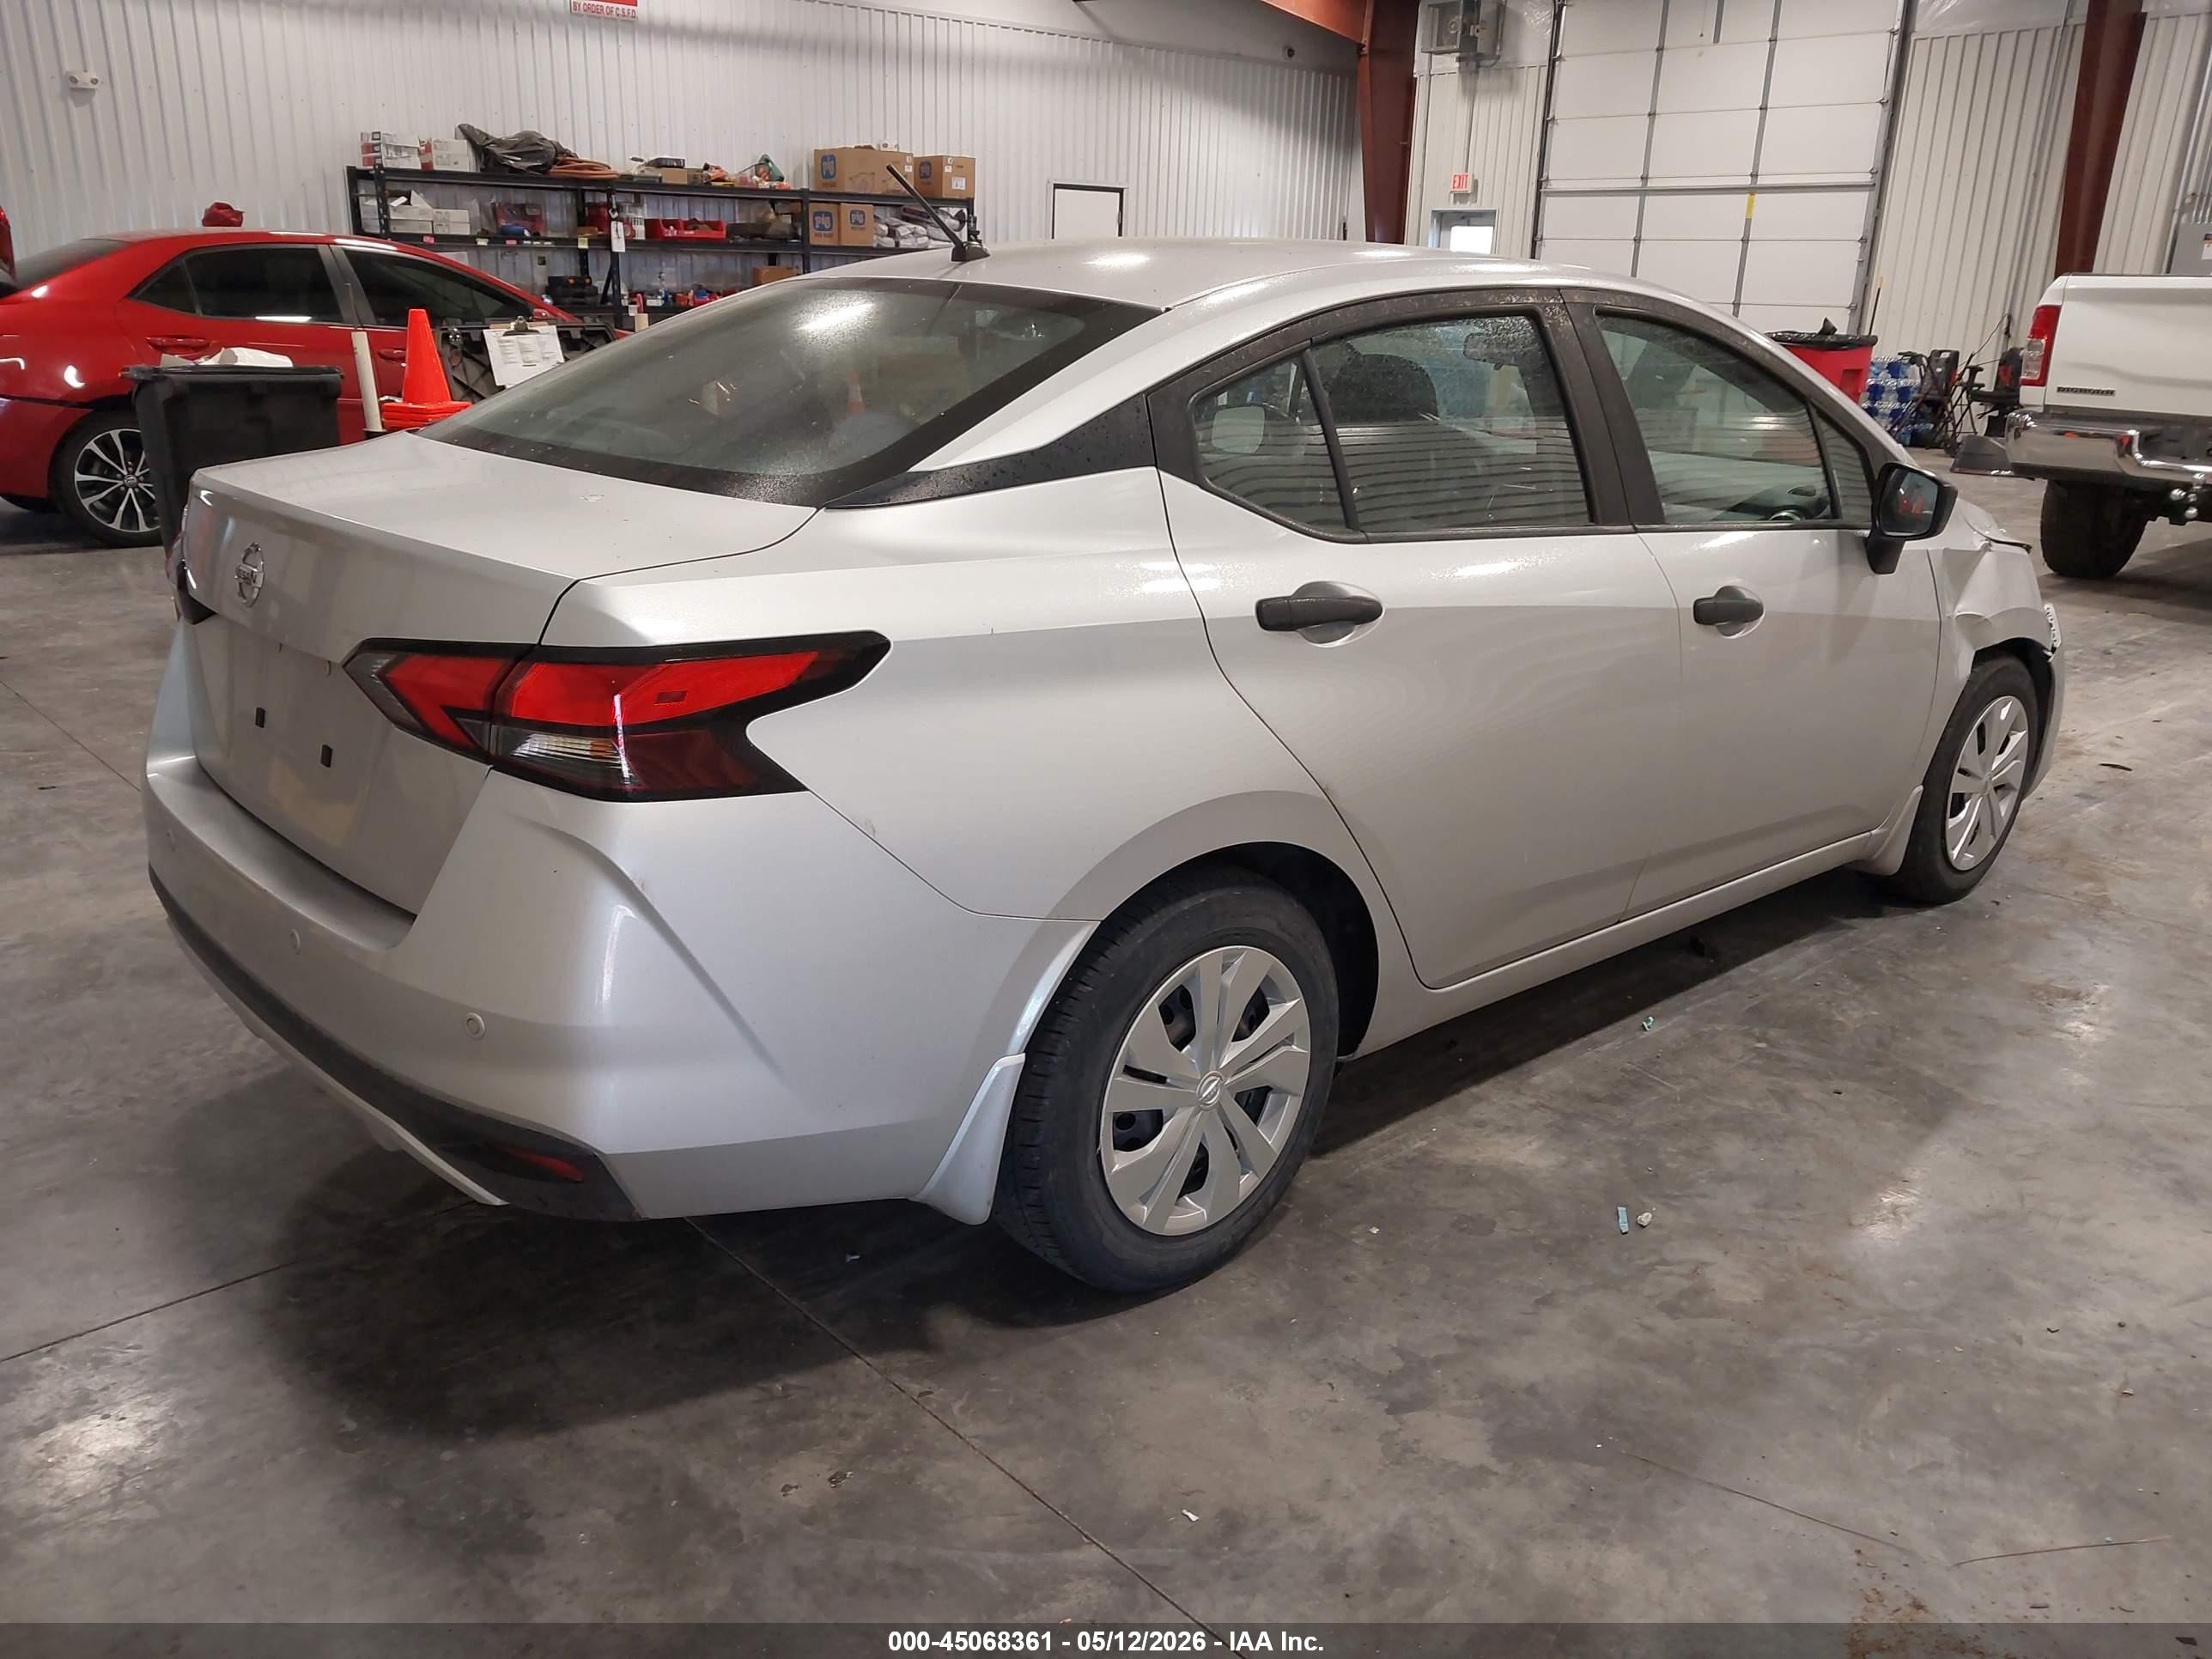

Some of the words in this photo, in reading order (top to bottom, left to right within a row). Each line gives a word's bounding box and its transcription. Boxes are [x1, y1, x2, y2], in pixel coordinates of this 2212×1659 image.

[573, 1, 581, 11] BY
[583, 3, 605, 15] ORDER
[605, 5, 614, 15] OF
[1452, 174, 1468, 189] EXIT
